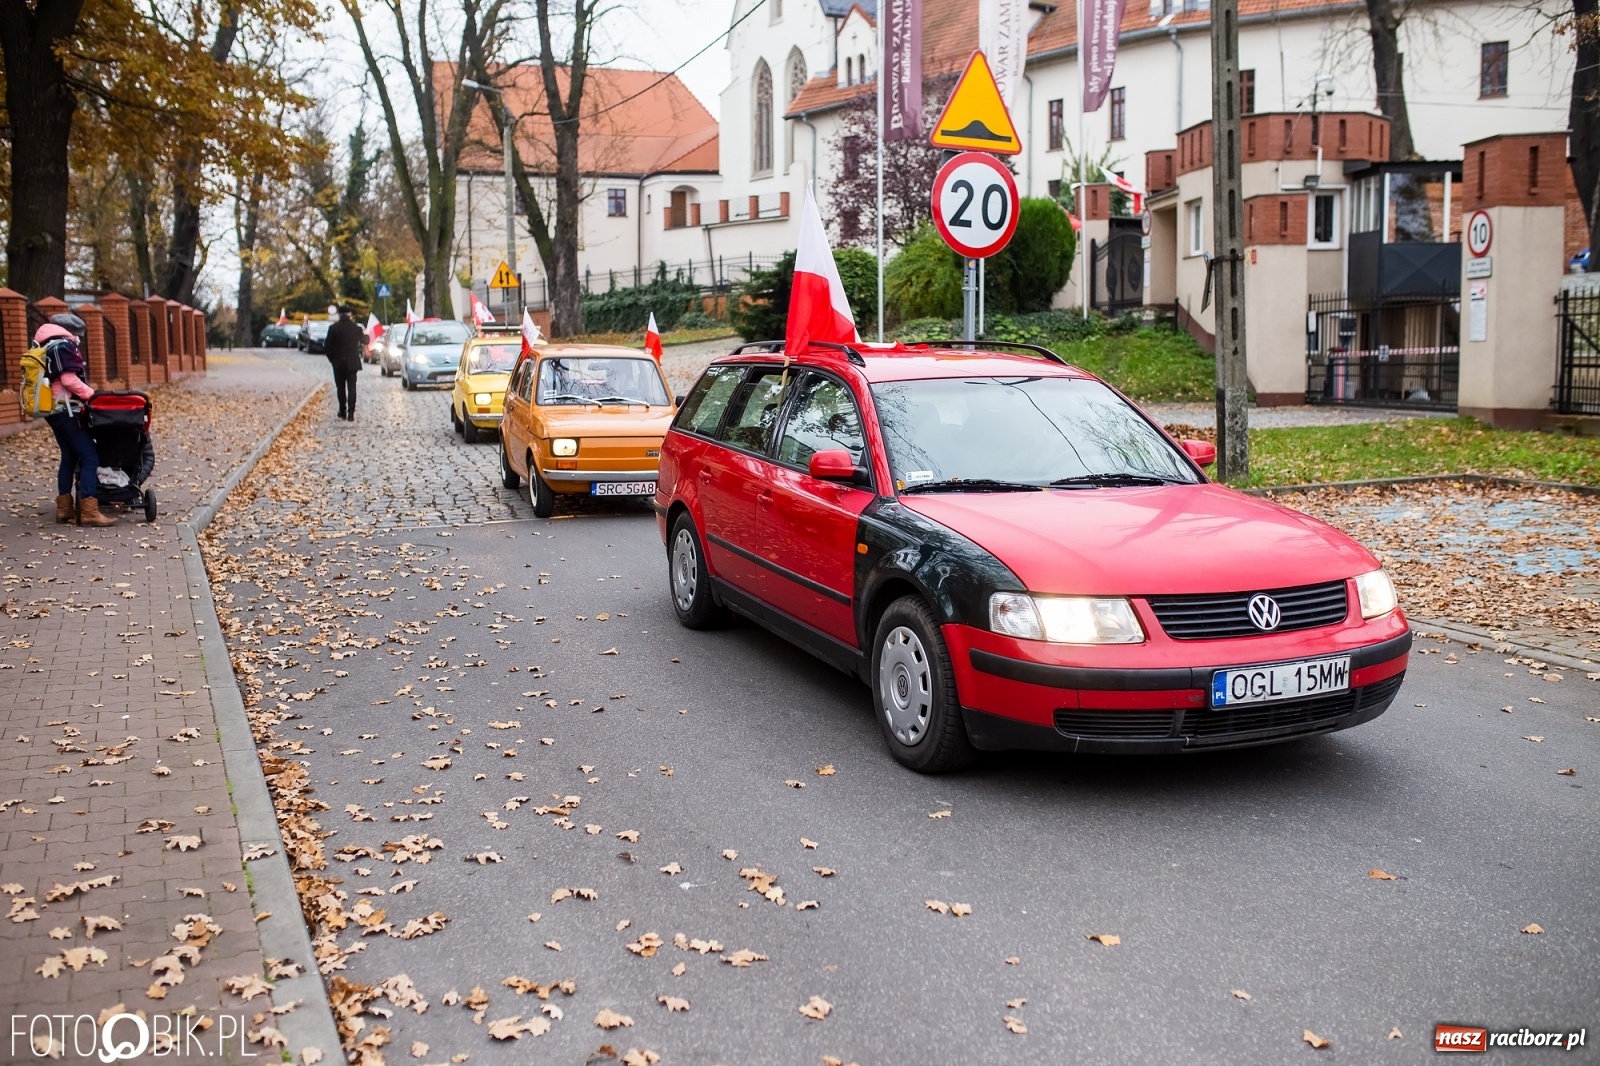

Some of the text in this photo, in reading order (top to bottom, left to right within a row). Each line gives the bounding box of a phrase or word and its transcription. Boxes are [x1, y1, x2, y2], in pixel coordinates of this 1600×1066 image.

[994, 44, 1010, 98] OWAR
[1089, 45, 1102, 73] piwo
[1089, 74, 1102, 93] My
[949, 179, 1008, 231] 20
[1473, 222, 1487, 245] 10
[598, 483, 623, 495] SRC
[626, 483, 654, 494] 5GA8
[1231, 660, 1348, 700] OGL 15MW
[1215, 691, 1225, 700] PL
